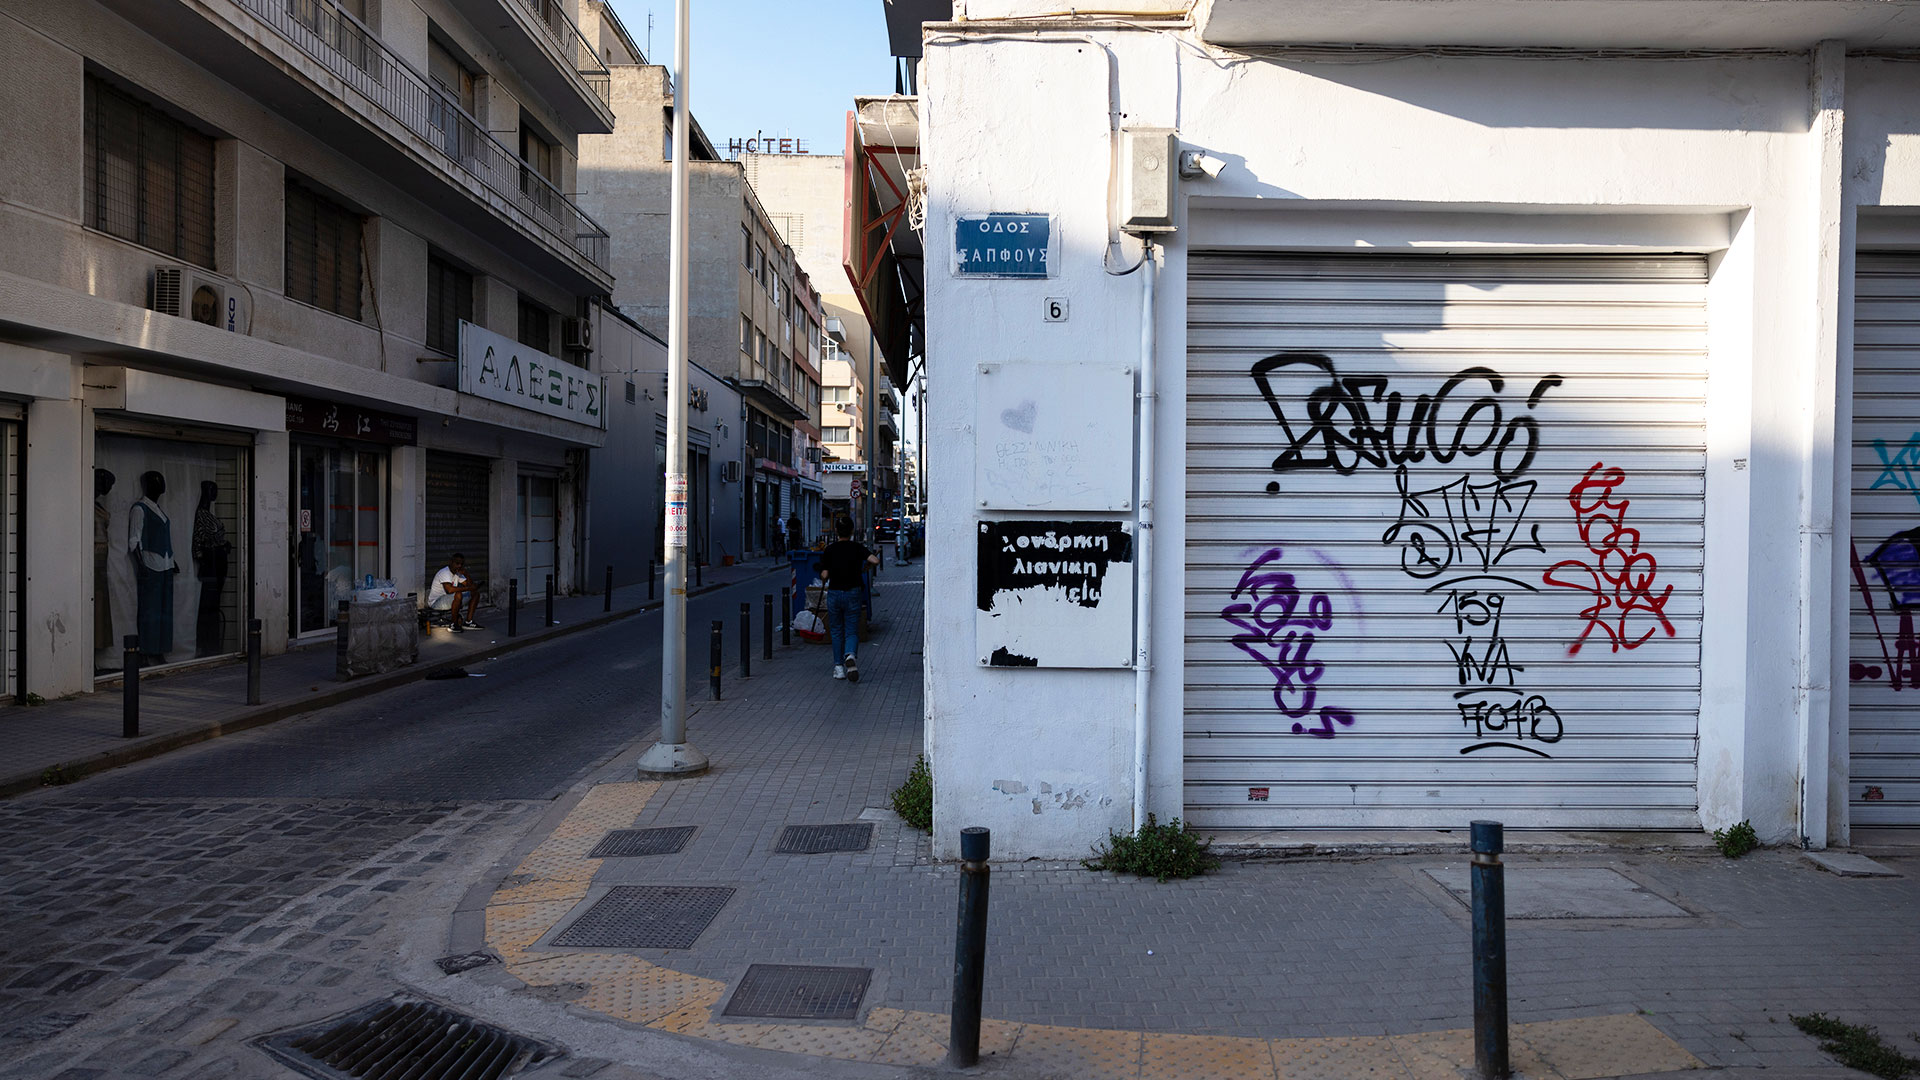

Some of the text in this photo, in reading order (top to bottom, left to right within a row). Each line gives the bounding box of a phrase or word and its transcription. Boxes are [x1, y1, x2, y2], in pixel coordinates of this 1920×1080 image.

[729, 137, 809, 153] HOTEL
[979, 222, 1030, 233] ΟΔΟΣ
[959, 248, 1048, 262] ΣΑΠΦΟΥΣ
[1050, 301, 1062, 319] 6
[479, 345, 598, 417] ΑΛΕΞΗΣ
[1013, 558, 1096, 576] λιανικη
